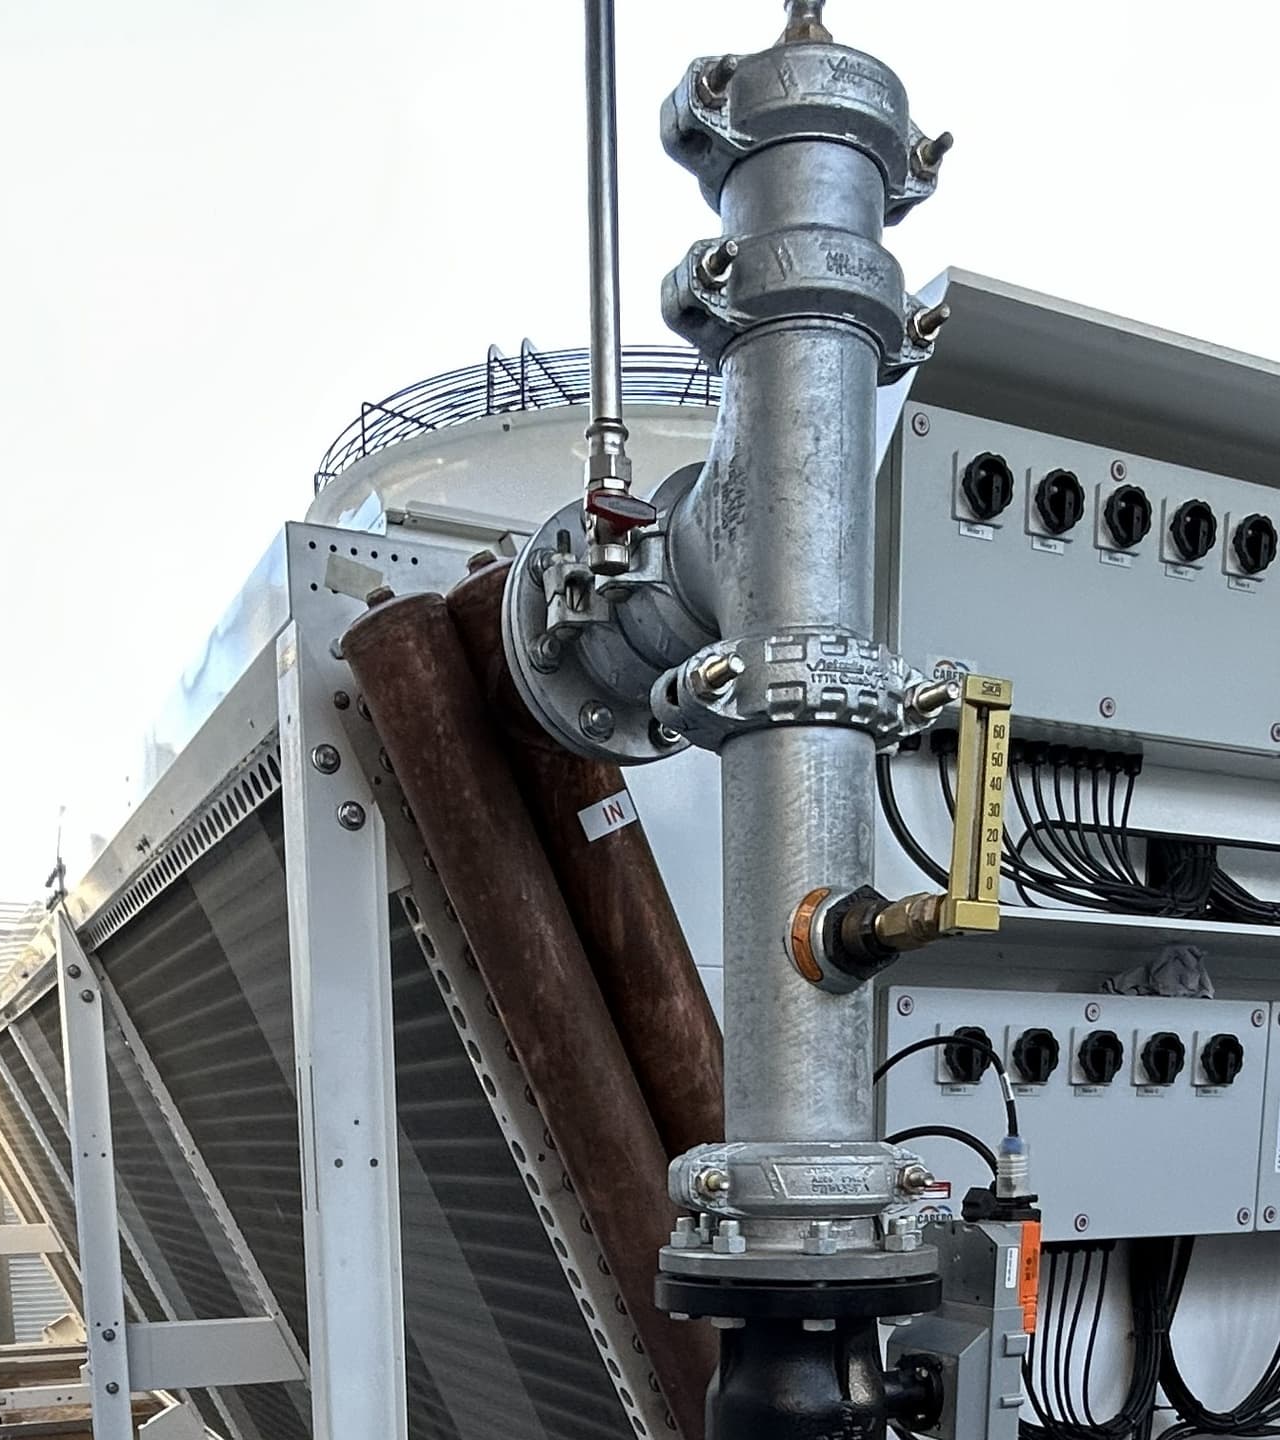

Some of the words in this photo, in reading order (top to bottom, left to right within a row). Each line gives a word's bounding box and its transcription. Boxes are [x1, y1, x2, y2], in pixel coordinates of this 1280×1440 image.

[933, 668, 965, 682] CABER
[993, 725, 1005, 739] 60
[991, 752, 1003, 767] 50
[989, 776, 1002, 791] 40
[602, 801, 625, 825] IN
[987, 803, 1000, 817] 30
[986, 828, 999, 843] 20
[986, 852, 996, 867] 10
[986, 876, 993, 890] 0
